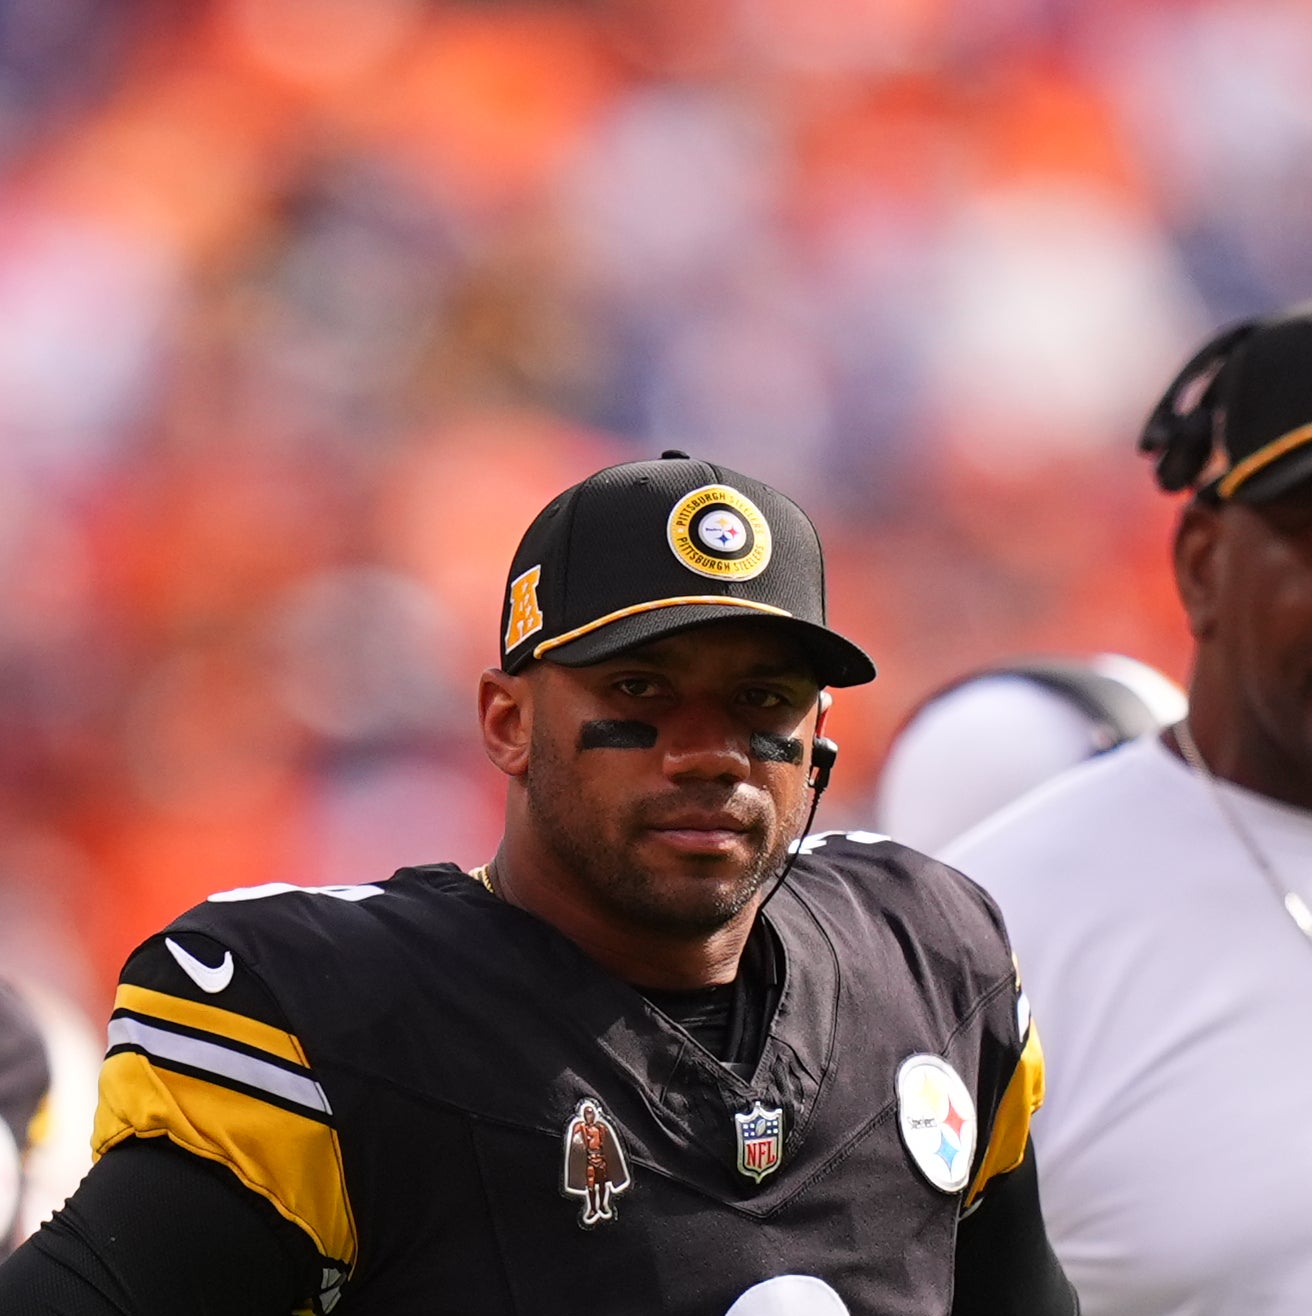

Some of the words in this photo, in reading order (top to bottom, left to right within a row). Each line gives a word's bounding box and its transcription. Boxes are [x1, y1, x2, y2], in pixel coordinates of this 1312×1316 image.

[676, 492, 726, 527] PITTSBURGH
[676, 536, 731, 572] PITTSBURGH
[733, 544, 765, 572] STEELERS
[746, 1141, 775, 1169] NFL
